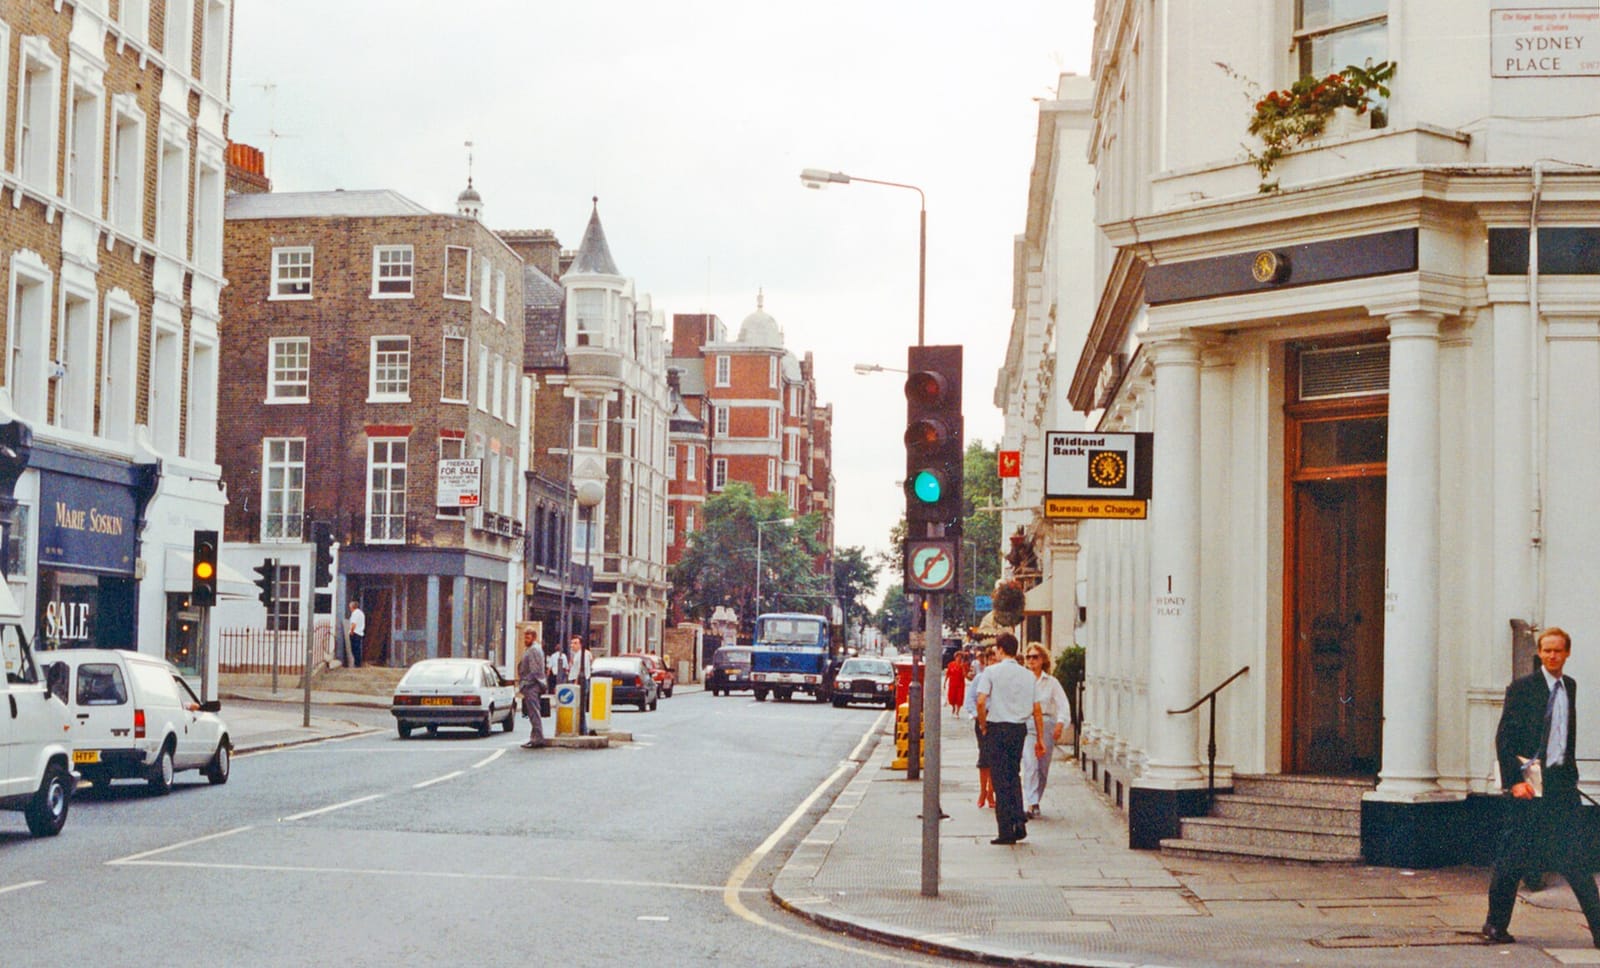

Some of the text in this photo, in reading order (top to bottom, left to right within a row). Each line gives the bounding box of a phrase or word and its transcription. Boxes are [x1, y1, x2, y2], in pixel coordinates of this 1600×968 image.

[1515, 36, 1584, 51] SYDNEY
[1506, 57, 1561, 71] PLACE
[1053, 437, 1105, 446] Midland
[1053, 447, 1085, 456] Bank
[441, 466, 479, 475] FOR SALE
[1049, 504, 1141, 515] Bureau de Change
[46, 601, 89, 640] SALE
